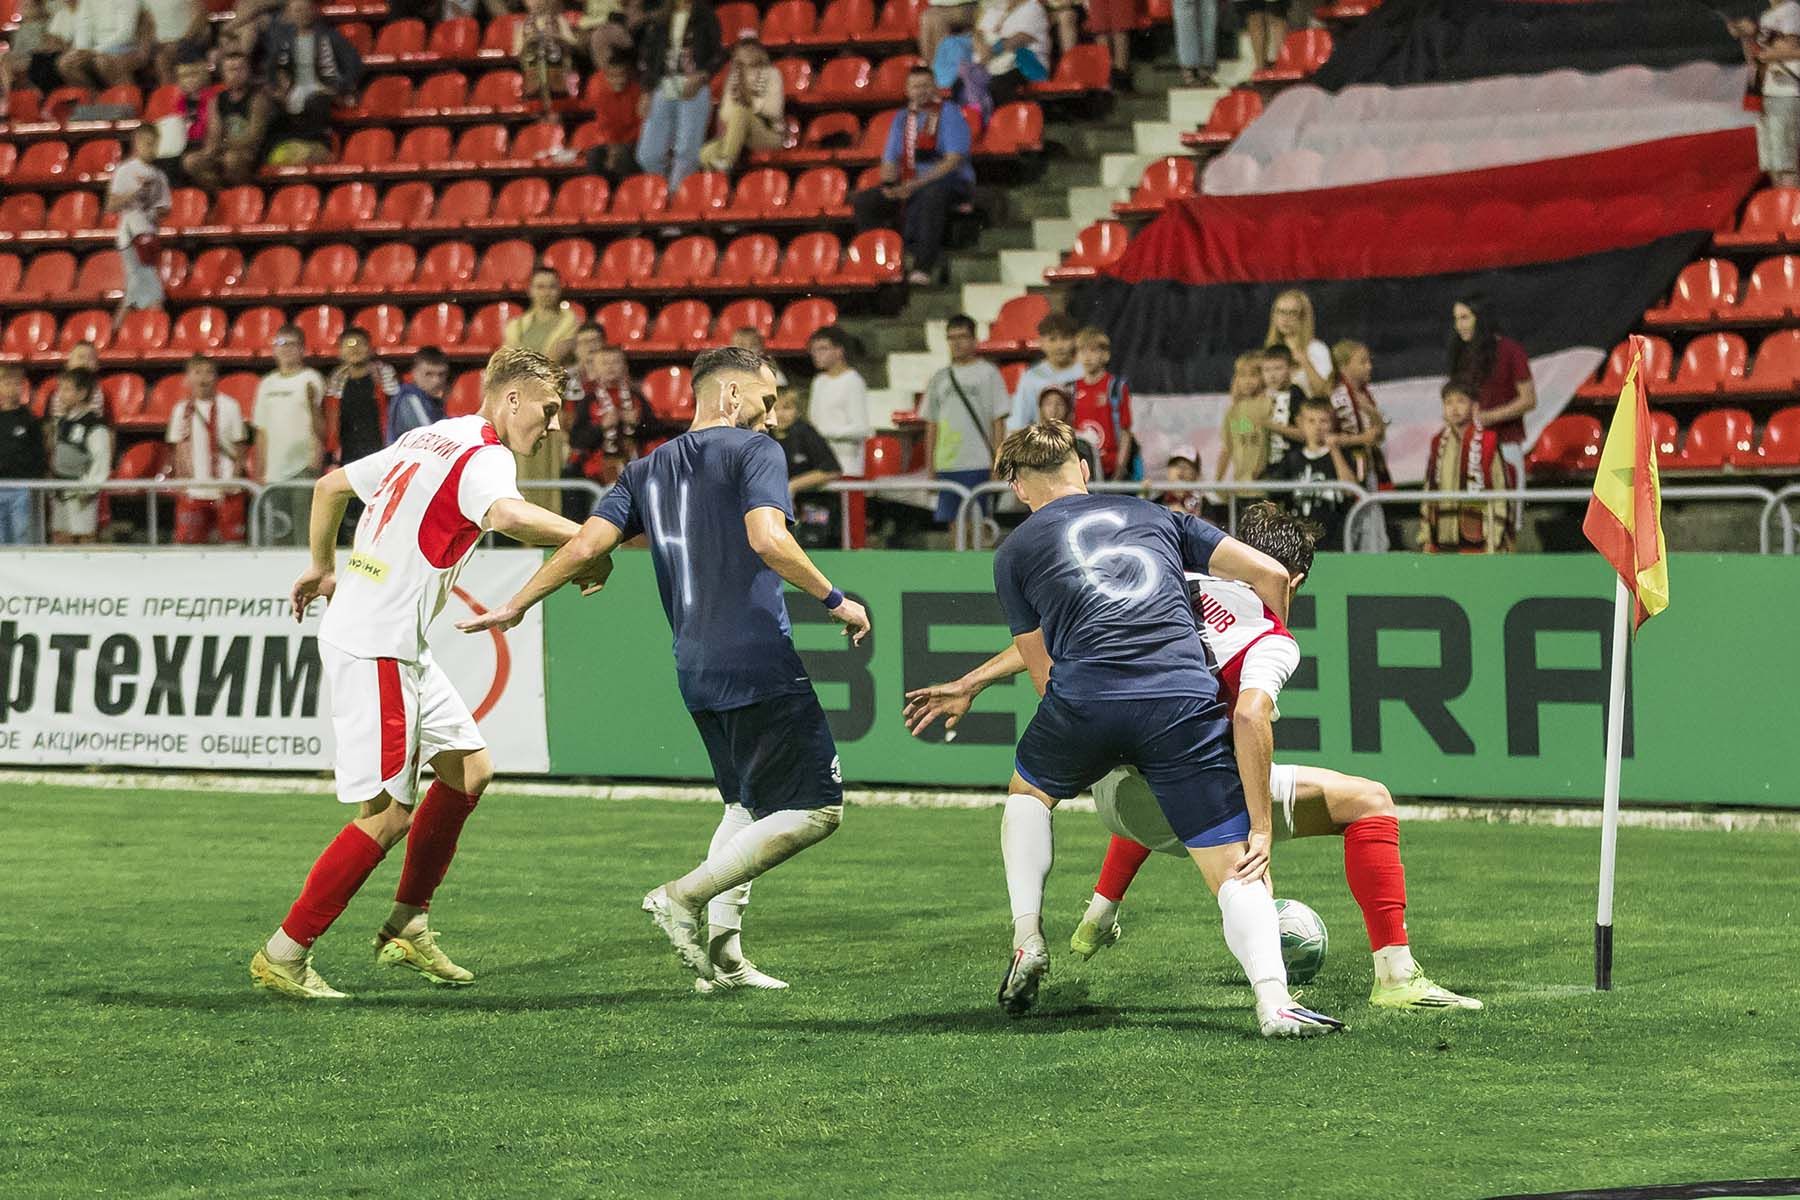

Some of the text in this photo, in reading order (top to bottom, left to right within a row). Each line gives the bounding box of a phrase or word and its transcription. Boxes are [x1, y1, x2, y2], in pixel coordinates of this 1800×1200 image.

[649, 480, 693, 606] 4
[1065, 510, 1160, 602] 6
[143, 597, 320, 622] ПРЕДПРИЯТЕ
[783, 591, 1635, 759] BERA
[33, 731, 188, 756] АКЦИОНЕРНОЕ
[201, 734, 322, 758] ОБЩЕСТВО
